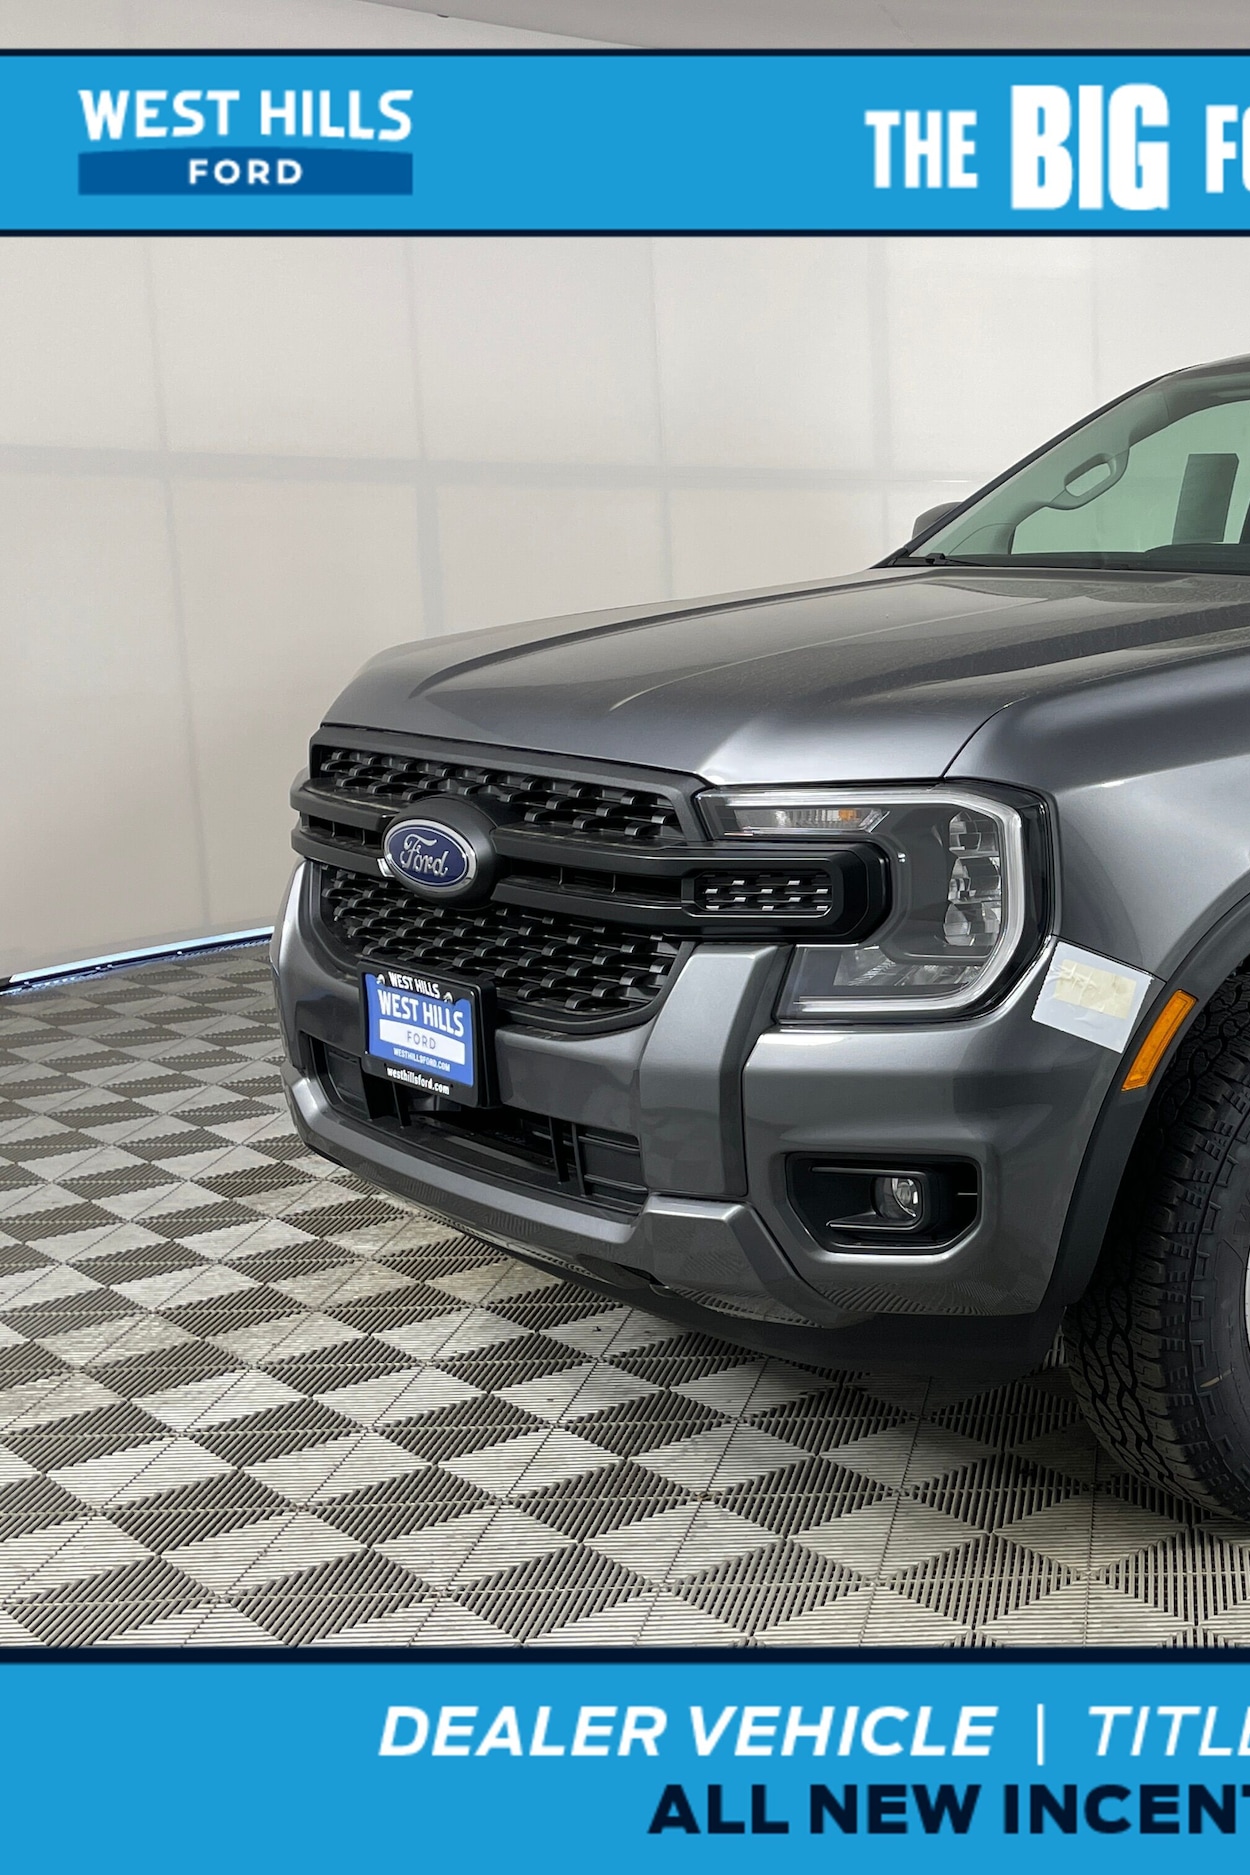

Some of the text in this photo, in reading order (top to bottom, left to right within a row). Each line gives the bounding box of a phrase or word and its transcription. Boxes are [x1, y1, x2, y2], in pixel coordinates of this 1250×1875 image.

[400, 833, 449, 877] Ford
[388, 971, 440, 999] WEST HILLS
[377, 989, 464, 1037] WEST HILLS
[406, 1030, 437, 1050] FORD
[393, 1047, 451, 1072] WESTHILLSFORD.COM
[386, 1066, 450, 1096] westhillsford.com
